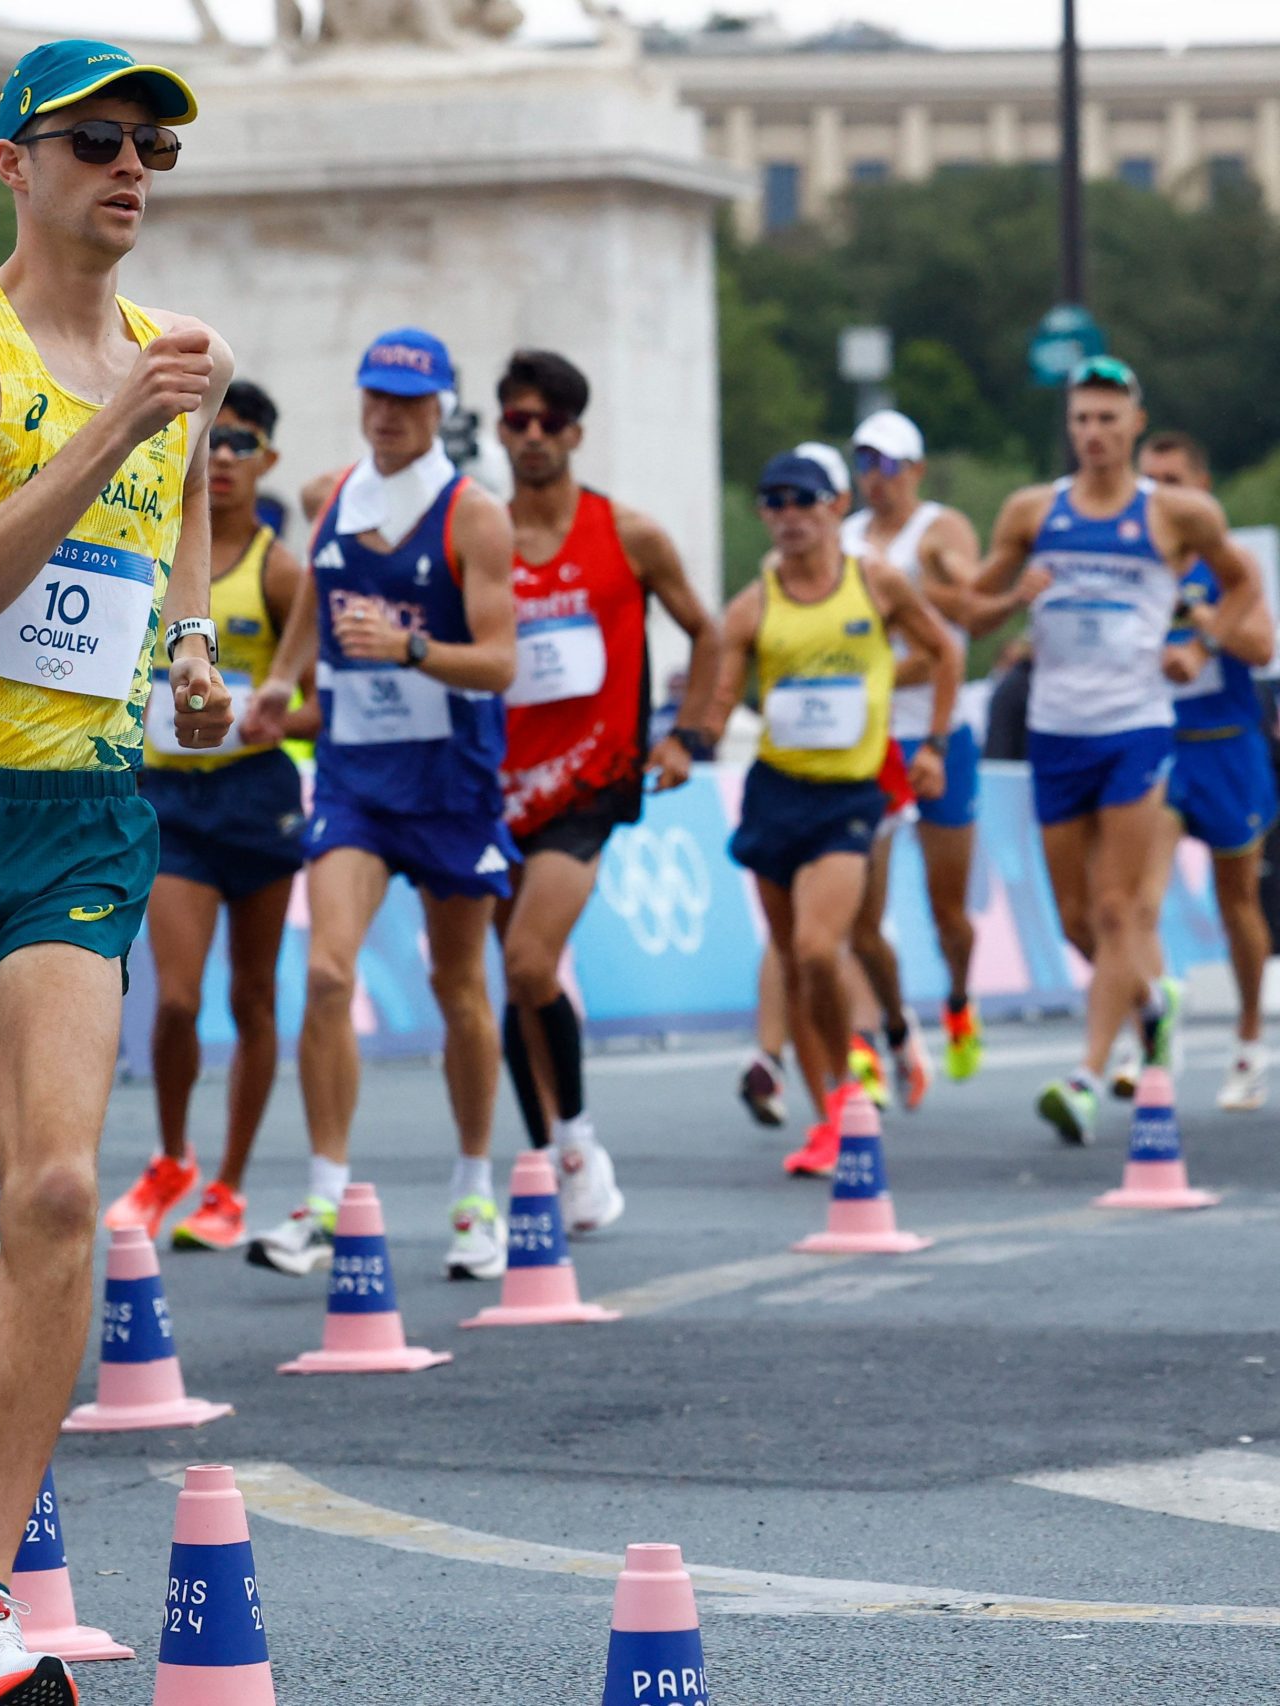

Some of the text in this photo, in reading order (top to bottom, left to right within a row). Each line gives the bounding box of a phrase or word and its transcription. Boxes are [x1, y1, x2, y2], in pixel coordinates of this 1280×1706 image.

[81, 550, 117, 568] 2024
[45, 580, 90, 626] 10
[19, 624, 99, 655] COWLEY
[163, 1605, 204, 1635] 24
